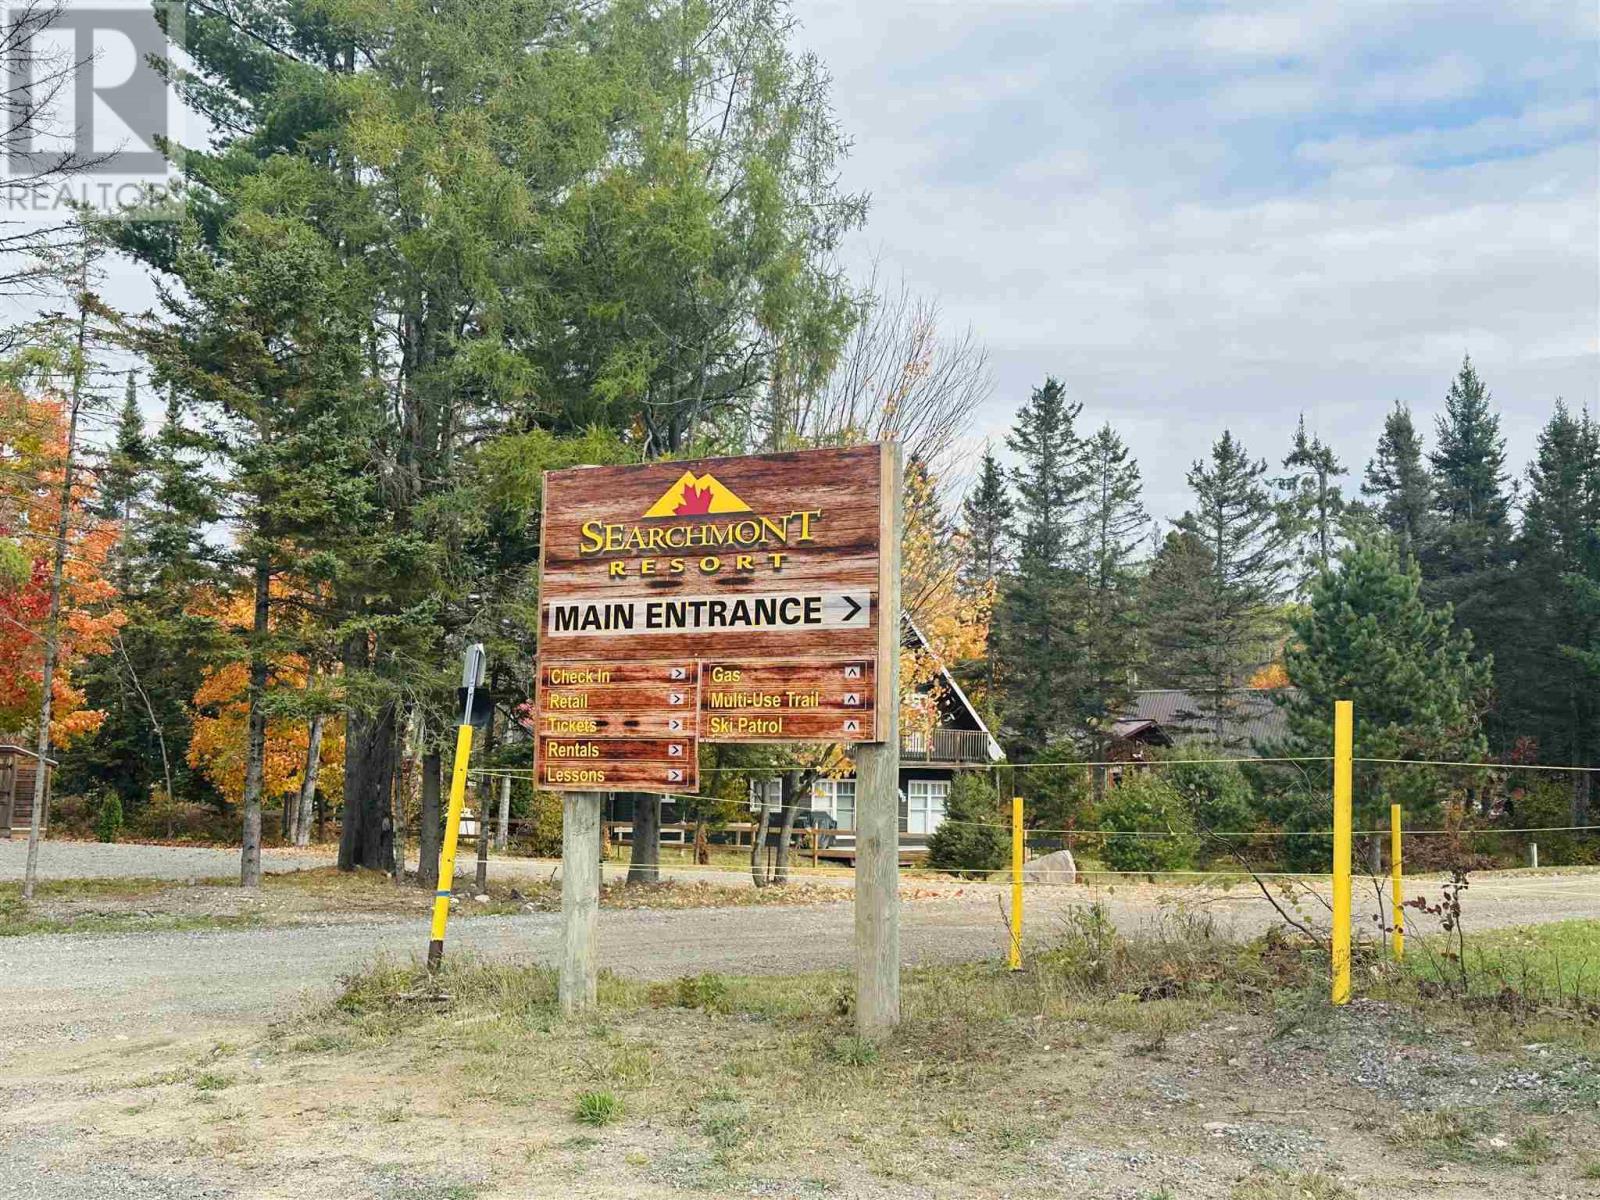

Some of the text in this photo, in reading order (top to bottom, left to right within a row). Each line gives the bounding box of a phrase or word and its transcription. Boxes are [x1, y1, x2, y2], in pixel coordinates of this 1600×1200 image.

[609, 553, 786, 576] RESORT
[554, 596, 822, 632] MAIN ENTRANCE
[551, 669, 610, 685] Check In
[712, 666, 741, 683] Gas
[550, 694, 588, 709] Retail
[711, 691, 819, 708] Multi-Use Trail
[549, 718, 597, 733] Tickets
[711, 717, 782, 734] Ski Patrol
[548, 742, 599, 758] Rentals
[547, 768, 605, 783] Lessons
